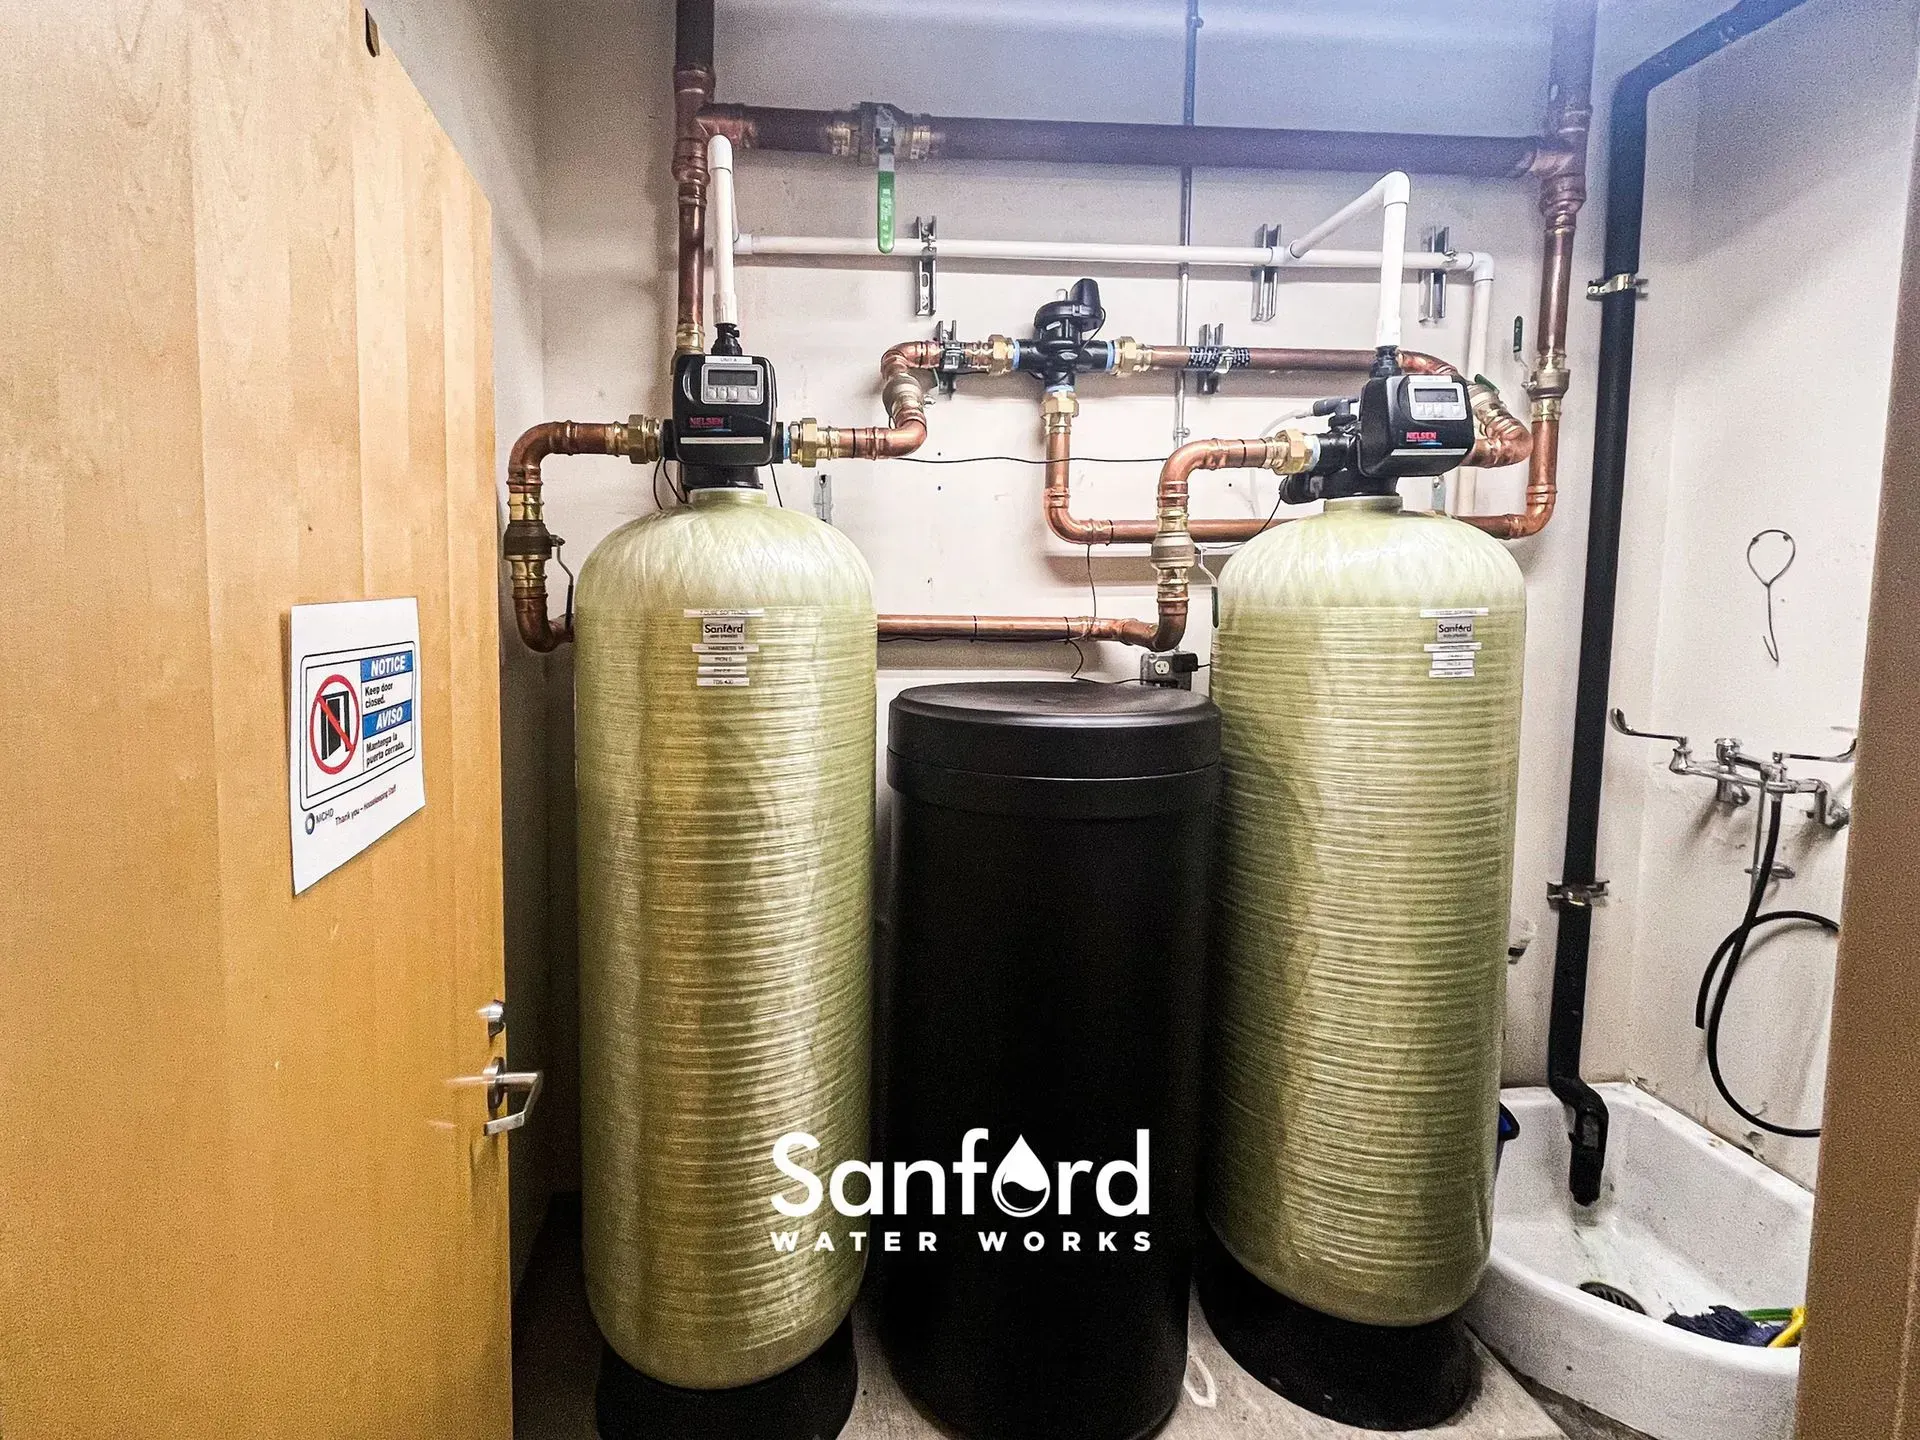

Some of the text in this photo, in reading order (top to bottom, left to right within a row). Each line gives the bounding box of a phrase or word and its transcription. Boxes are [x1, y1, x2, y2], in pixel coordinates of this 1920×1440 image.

[689, 417, 724, 425] NELSEN
[1406, 431, 1437, 439] NELSEN
[704, 624, 743, 633] Sanford
[1438, 624, 1472, 633] Sanford
[371, 655, 406, 677] NOTICE
[365, 682, 393, 697] Keep door
[365, 695, 386, 709] closed.
[375, 706, 403, 731] AVISO
[366, 732, 398, 753] Mantenga la
[366, 750, 384, 768] puerta
[335, 811, 350, 826] Thank
[351, 808, 360, 820] you
